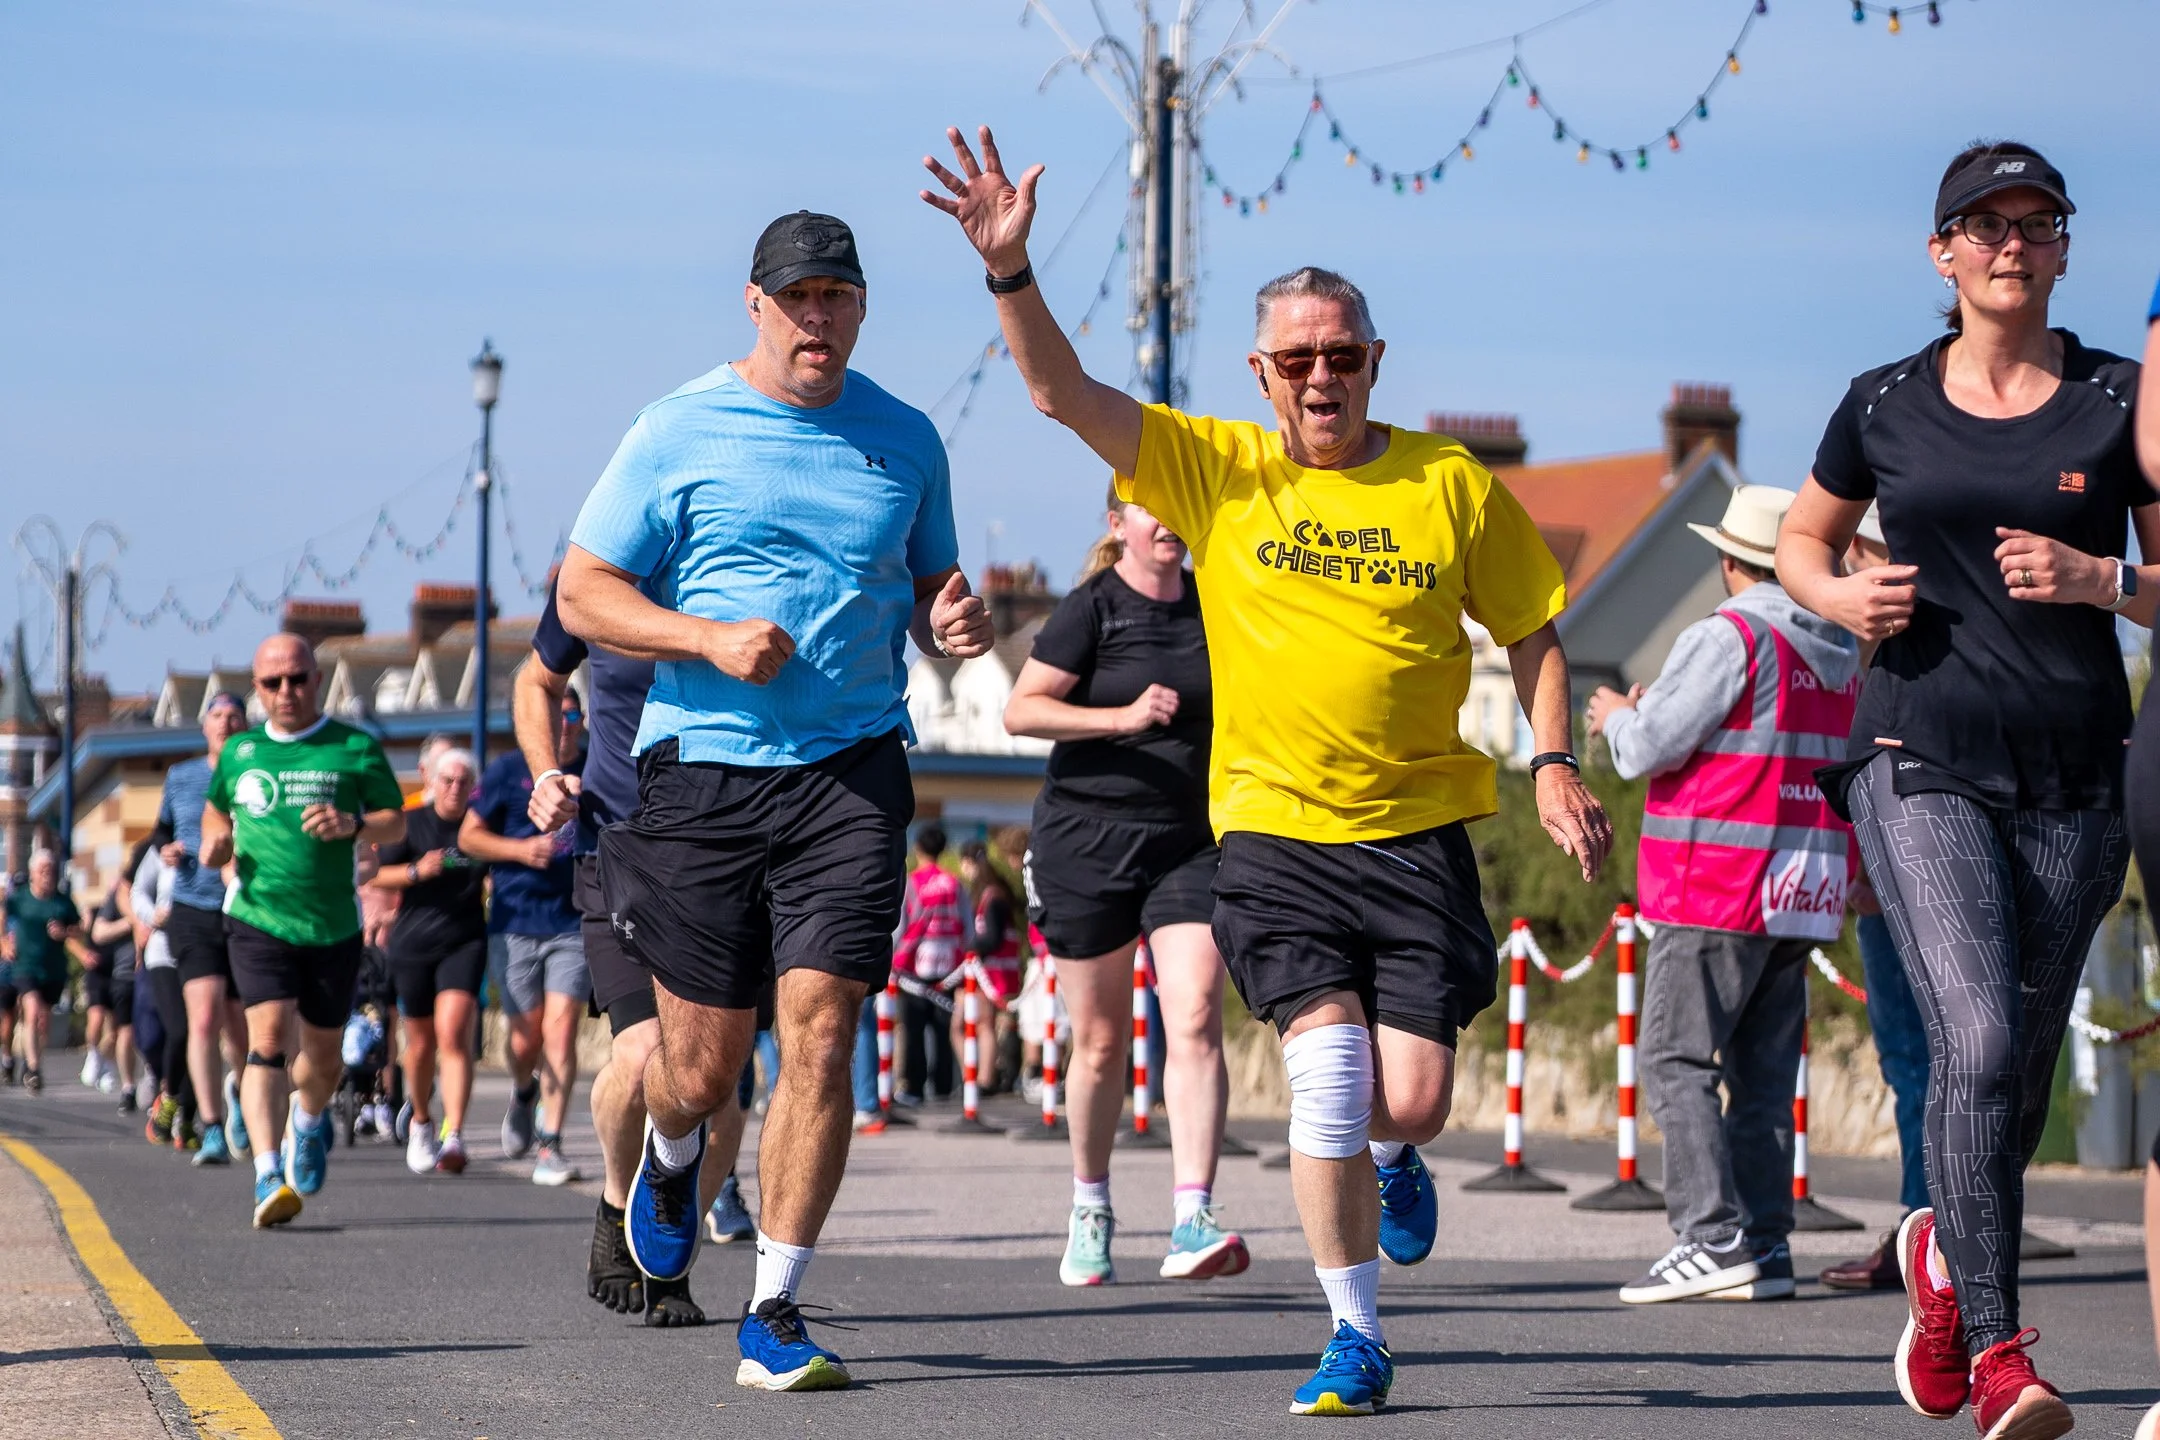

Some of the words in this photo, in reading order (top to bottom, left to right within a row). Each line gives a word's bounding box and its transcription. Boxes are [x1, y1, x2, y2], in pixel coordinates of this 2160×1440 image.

[1293, 519, 1400, 554] CPEL
[1256, 540, 1437, 591] CHEETHS
[1769, 863, 1846, 932] Vitality
